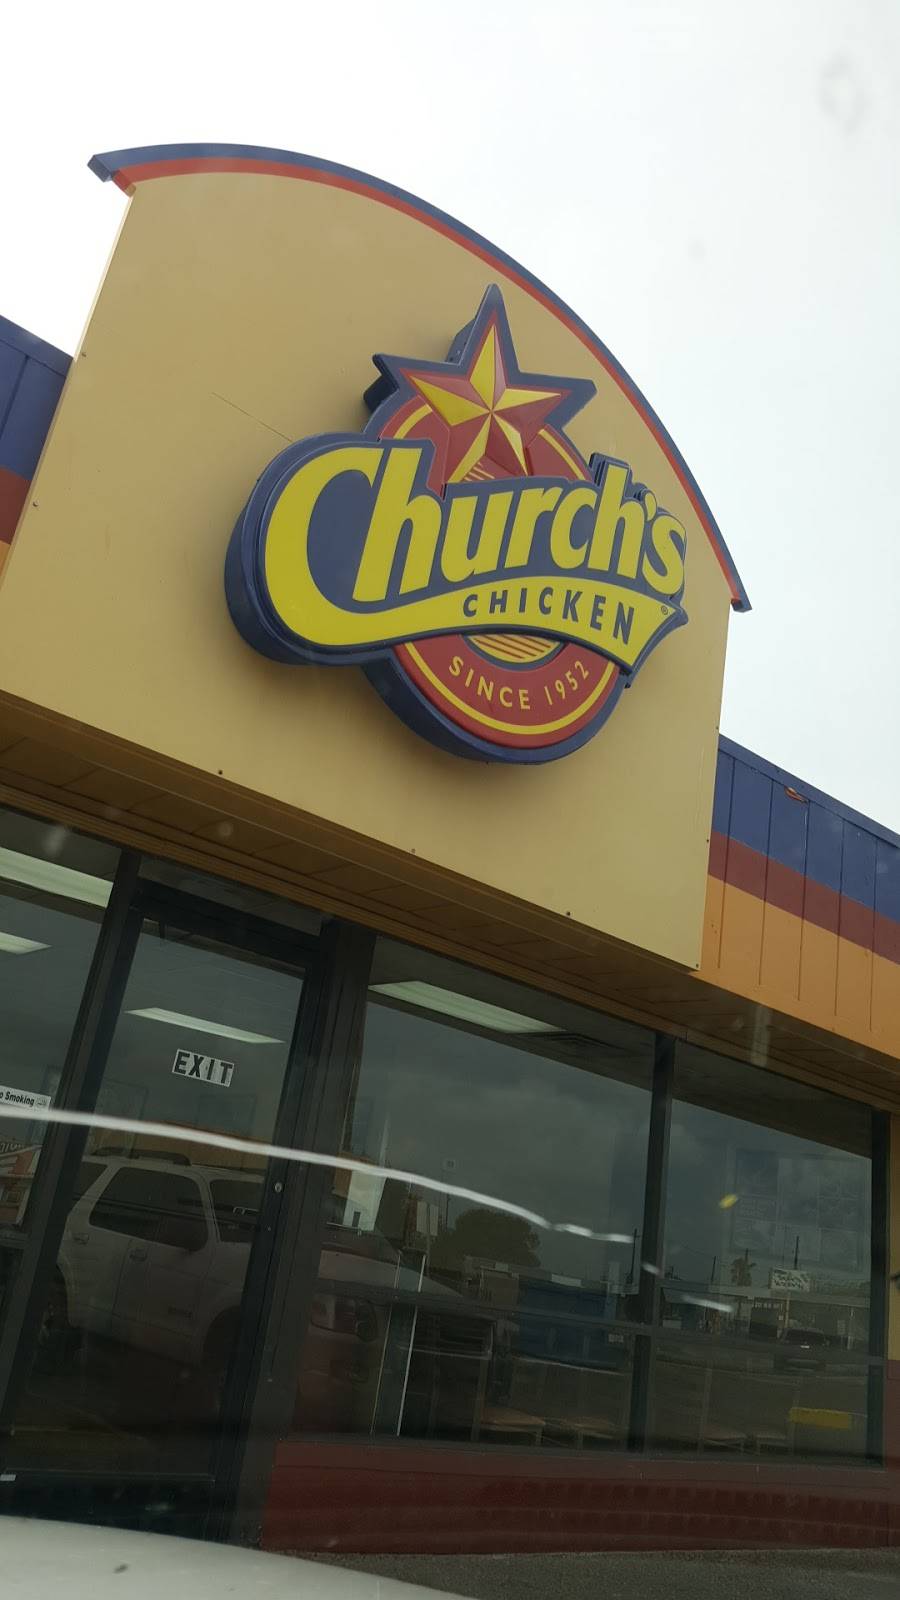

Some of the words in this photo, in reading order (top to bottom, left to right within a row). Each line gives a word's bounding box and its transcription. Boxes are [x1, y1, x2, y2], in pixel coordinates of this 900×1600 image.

[264, 447, 687, 647] Church's
[462, 586, 635, 645] CHICKEN
[448, 655, 531, 710] SINCE
[544, 660, 590, 706] 1952
[173, 1051, 233, 1085] EXIT
[5, 1091, 35, 1107] Smoking
